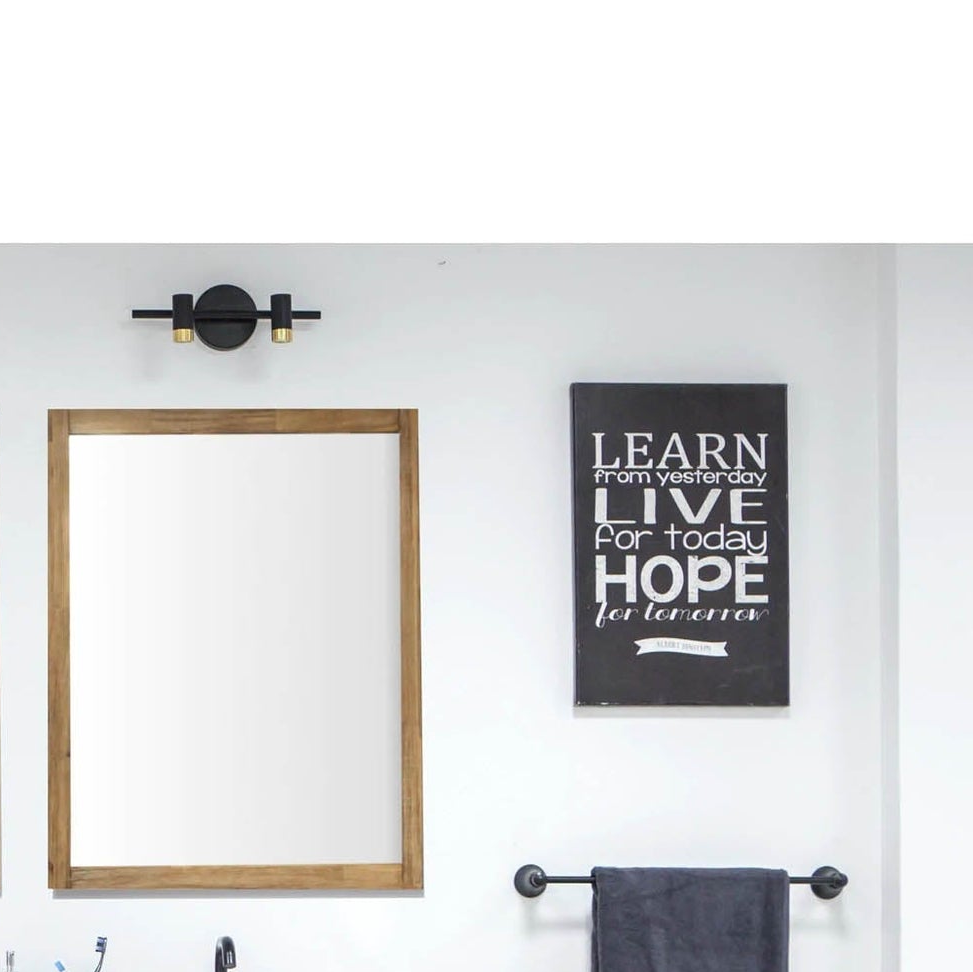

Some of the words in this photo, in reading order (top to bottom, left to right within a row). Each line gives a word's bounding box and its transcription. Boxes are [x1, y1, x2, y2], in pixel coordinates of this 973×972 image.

[592, 432, 768, 469] LEARN
[594, 469, 651, 484] from
[656, 469, 767, 486] yesterday
[595, 488, 768, 524] LIVE
[595, 523, 653, 550] for
[664, 523, 768, 556] today
[595, 555, 769, 603] HOPE
[595, 601, 639, 628] for
[644, 602, 769, 622] tomorrow
